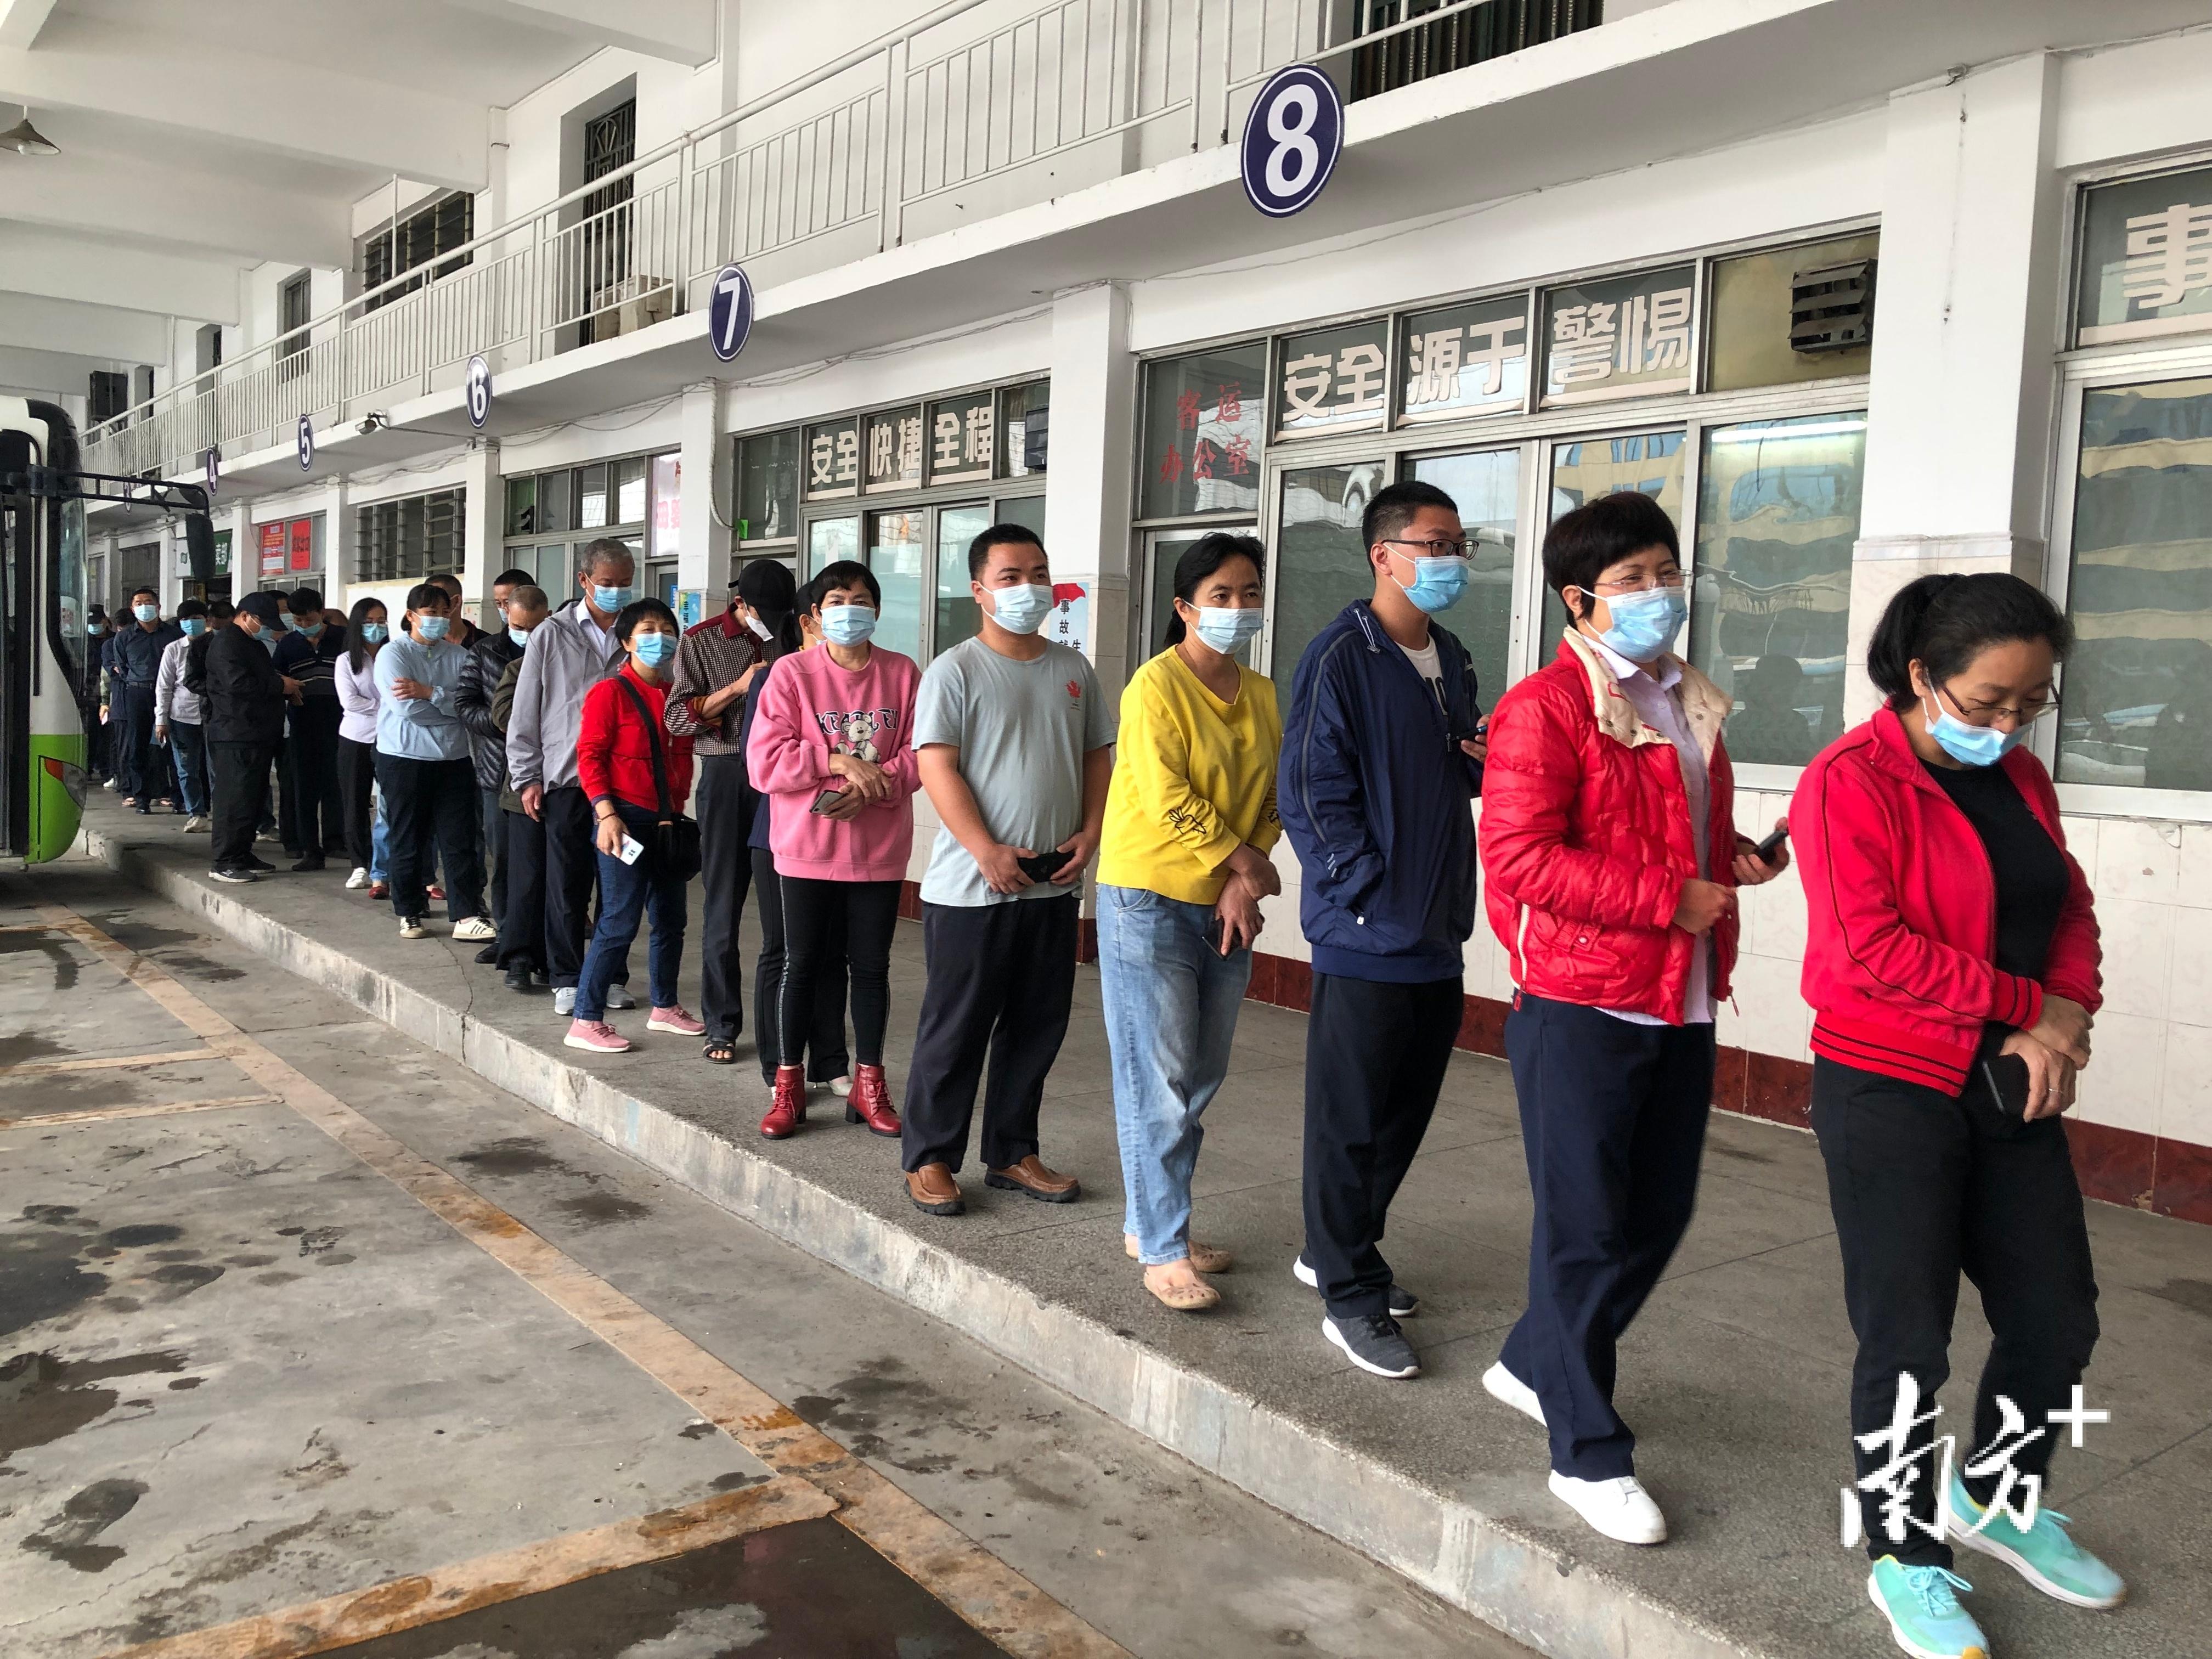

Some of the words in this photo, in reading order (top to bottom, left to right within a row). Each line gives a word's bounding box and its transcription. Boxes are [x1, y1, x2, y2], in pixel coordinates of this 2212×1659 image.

[1265, 84, 1319, 197] 8
[2123, 203, 2212, 309] 事
[719, 276, 740, 350] 7
[472, 364, 486, 419] 6
[1177, 381, 1242, 430] 客运
[300, 422, 311, 464] 5
[1159, 434, 1250, 484] 办公室
[210, 454, 216, 489] 4
